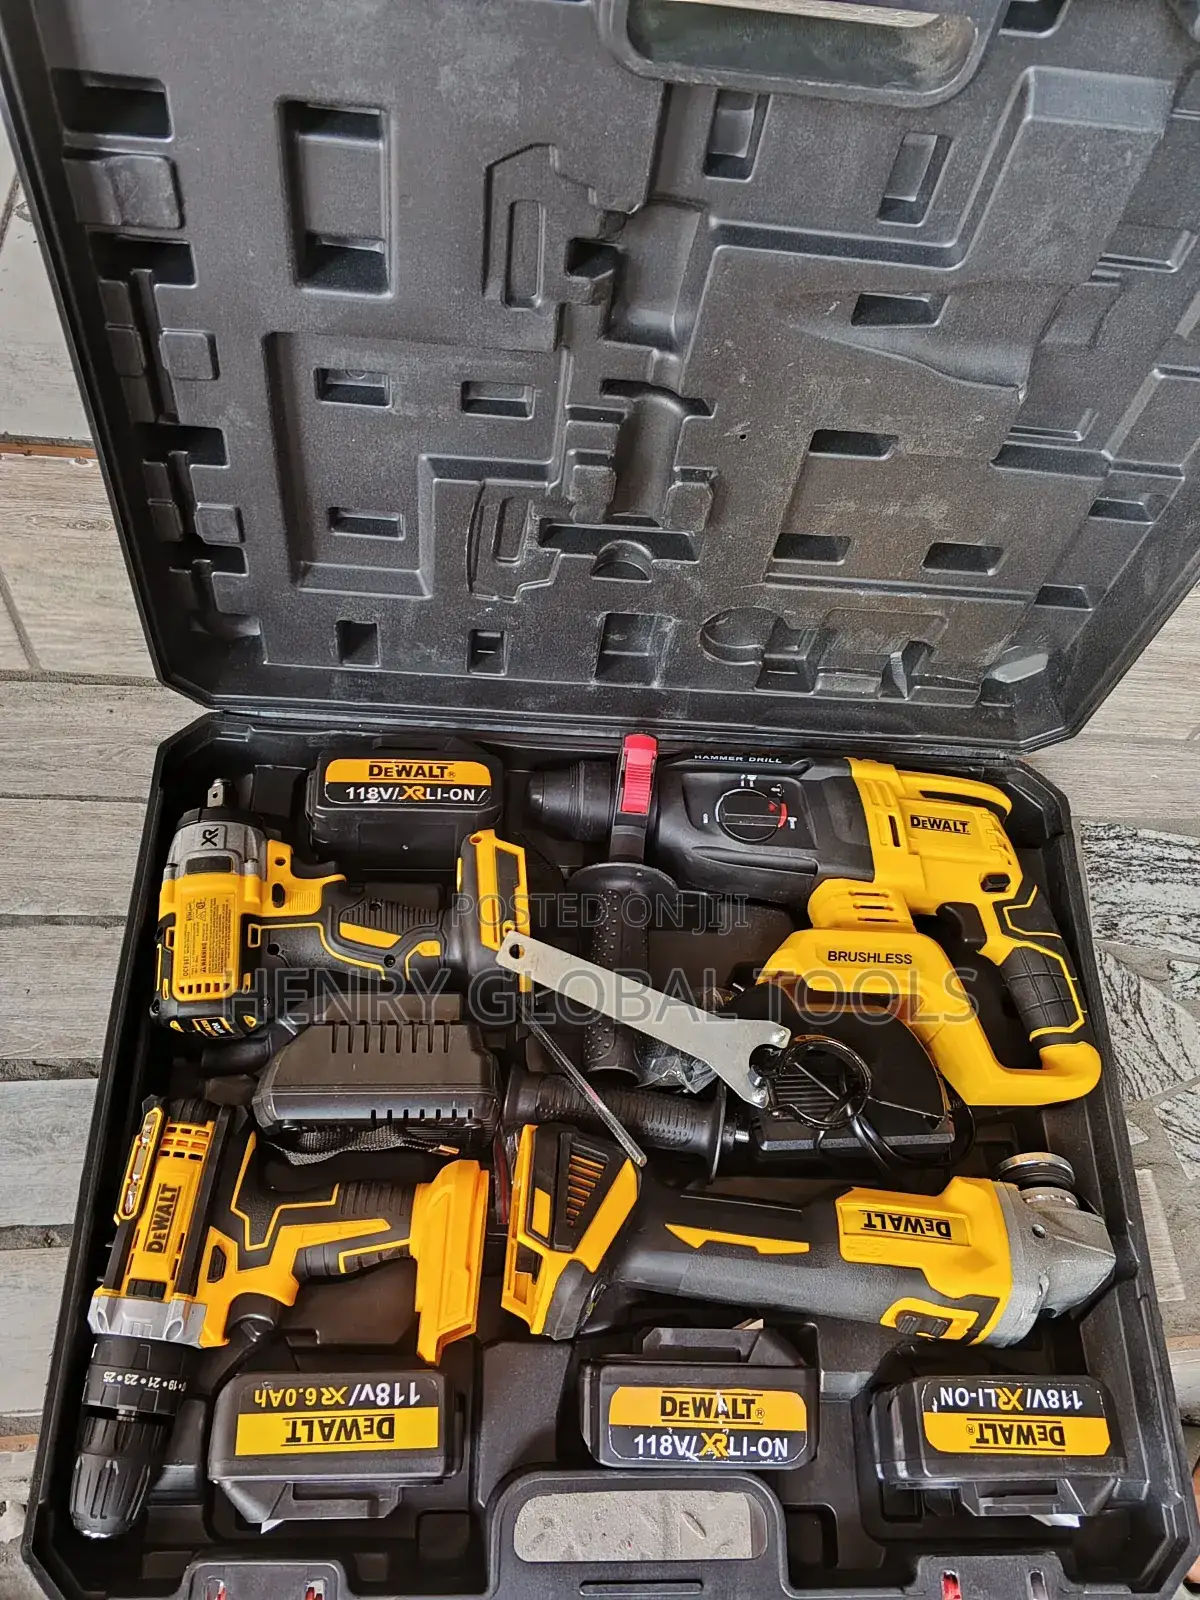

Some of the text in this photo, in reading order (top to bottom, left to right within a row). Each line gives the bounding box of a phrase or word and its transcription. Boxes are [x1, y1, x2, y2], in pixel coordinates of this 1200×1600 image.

[694, 754, 744, 762] HAMMER
[910, 815, 969, 833] DEWALT
[827, 950, 913, 965] BRUSHLESS
[145, 1183, 178, 1254] DEWALT
[103, 1371, 117, 1383] 25
[124, 1373, 139, 1386] 23
[148, 1376, 161, 1388] 21
